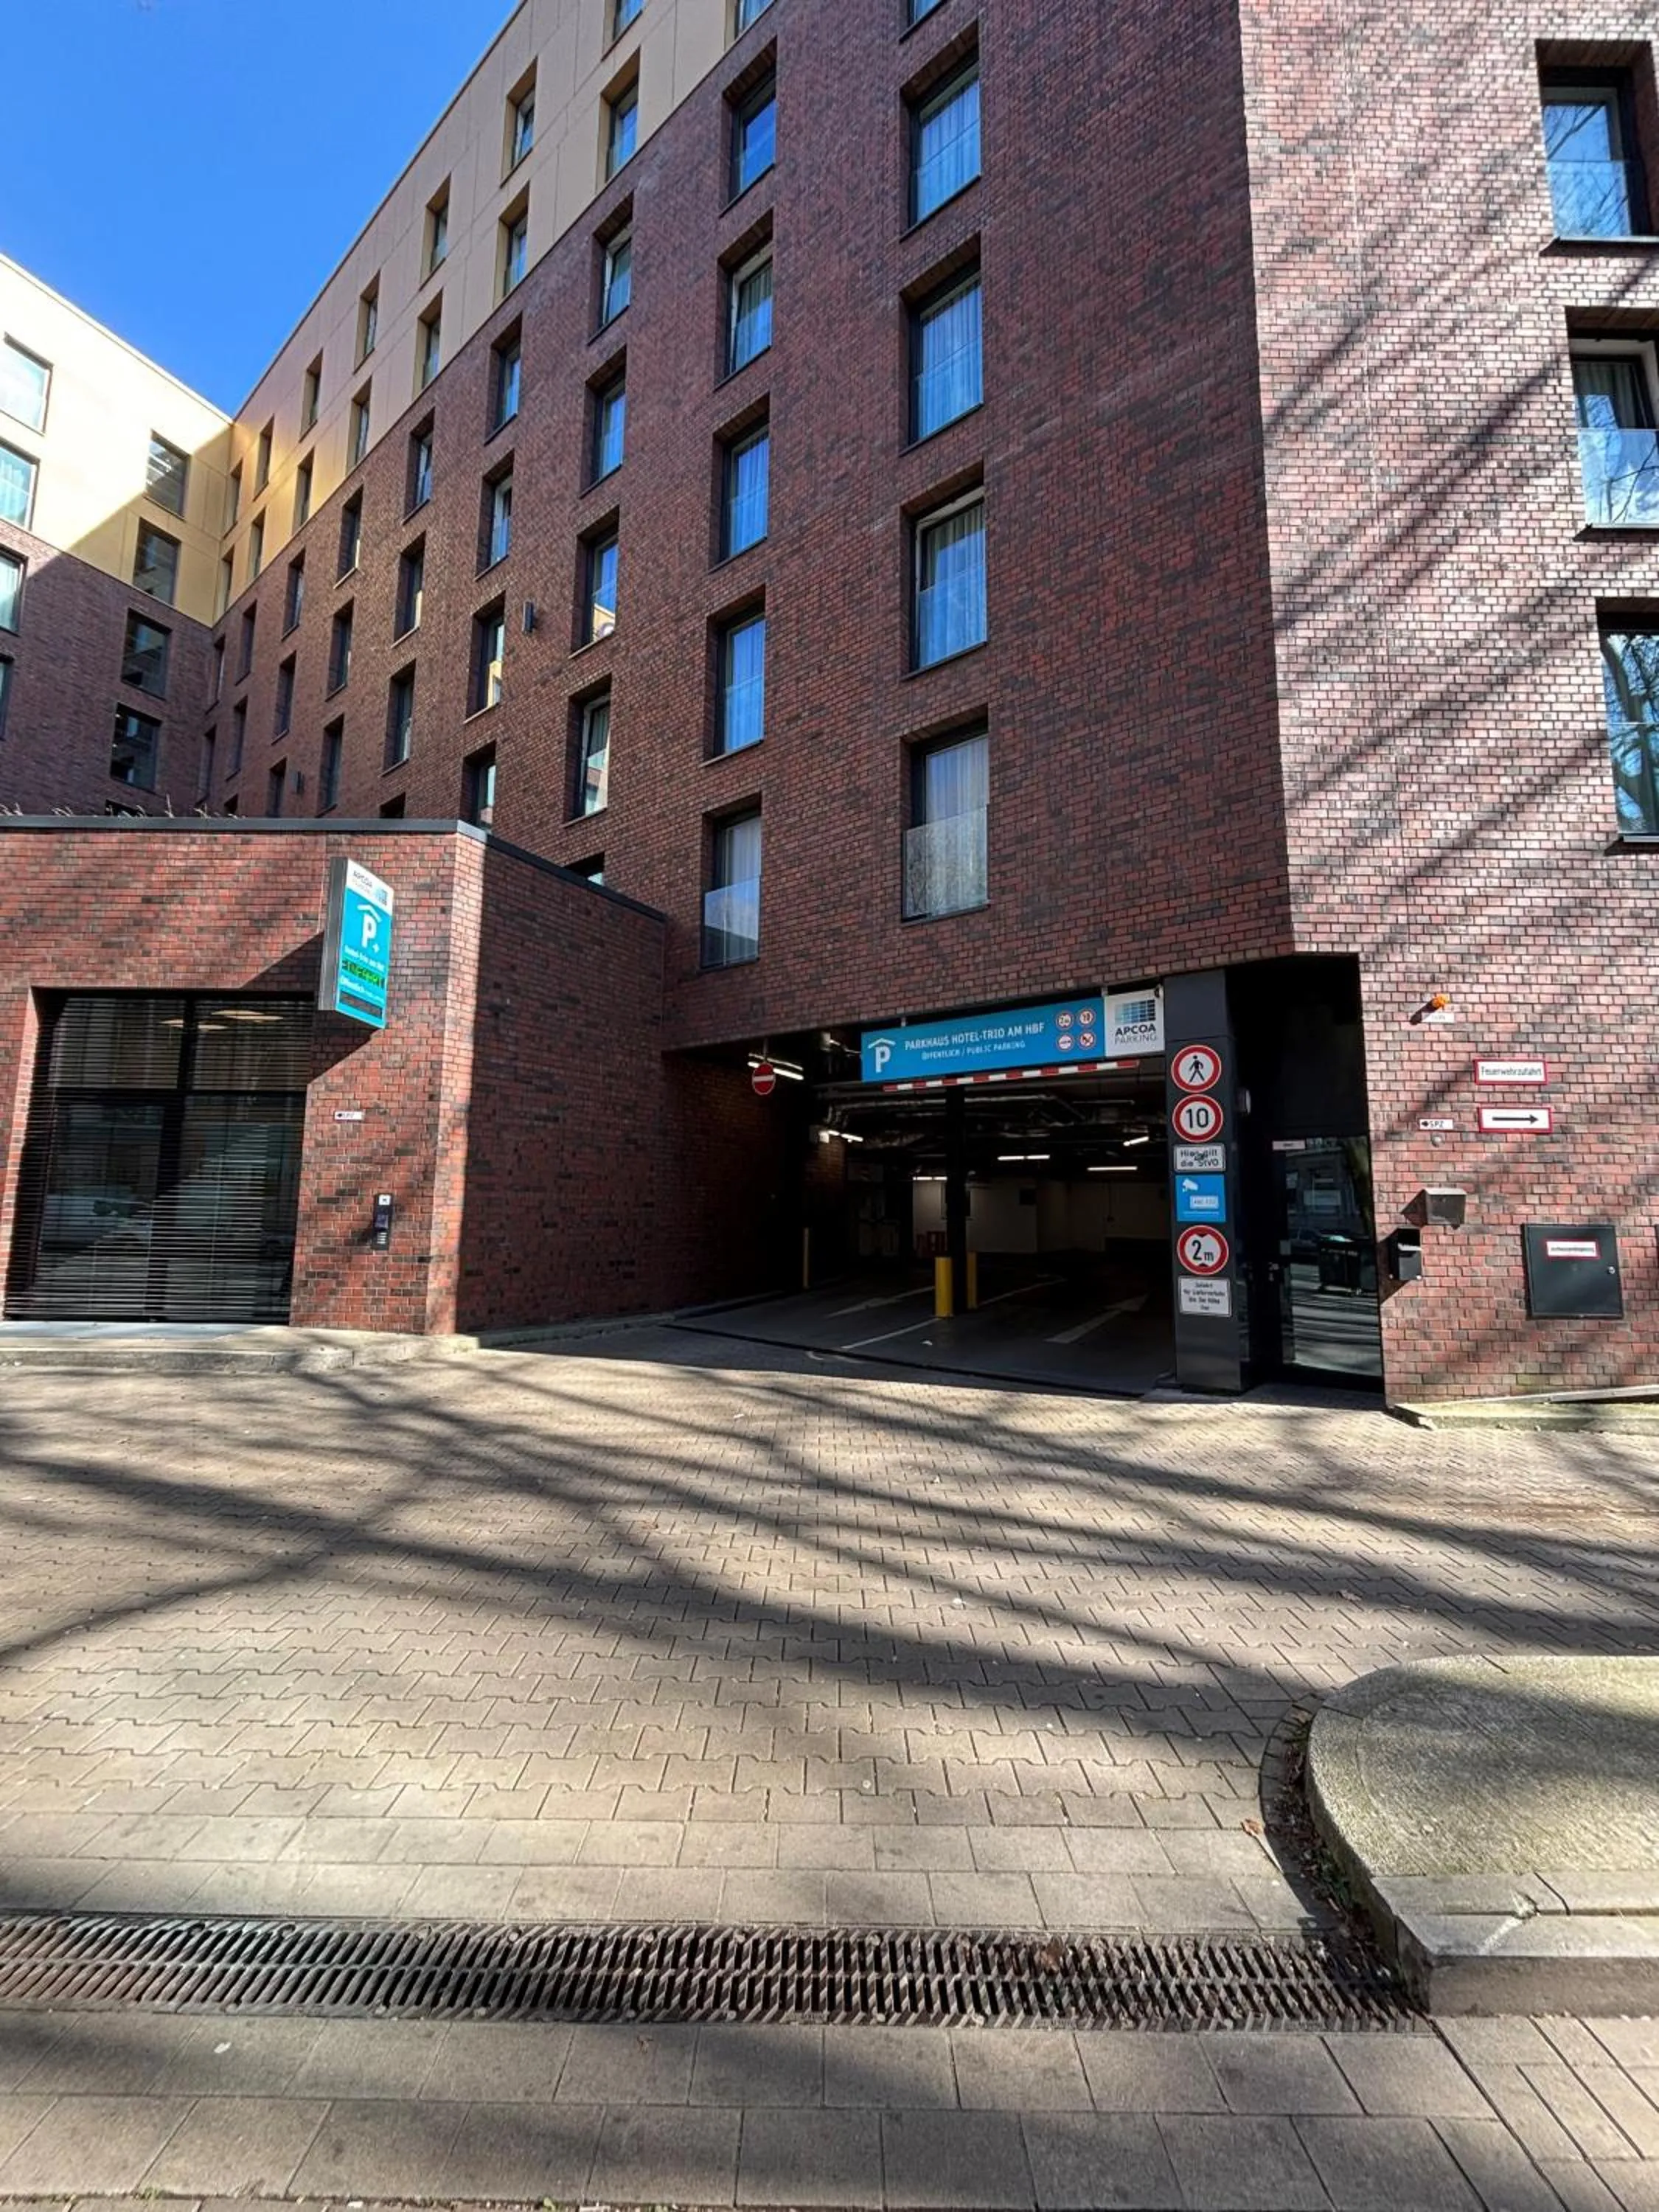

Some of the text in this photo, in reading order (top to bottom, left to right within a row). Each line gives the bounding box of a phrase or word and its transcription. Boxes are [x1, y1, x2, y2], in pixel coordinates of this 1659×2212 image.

[905, 1022, 1045, 1051] PARKHAUS HOTEL-TRIO AM HBF
[1116, 1023, 1157, 1036] APCOA
[967, 1043, 991, 1054] PUBLIC
[993, 1039, 1026, 1051] PARKING
[1115, 1033, 1157, 1045] PARKING
[1186, 1107, 1209, 1129] 10
